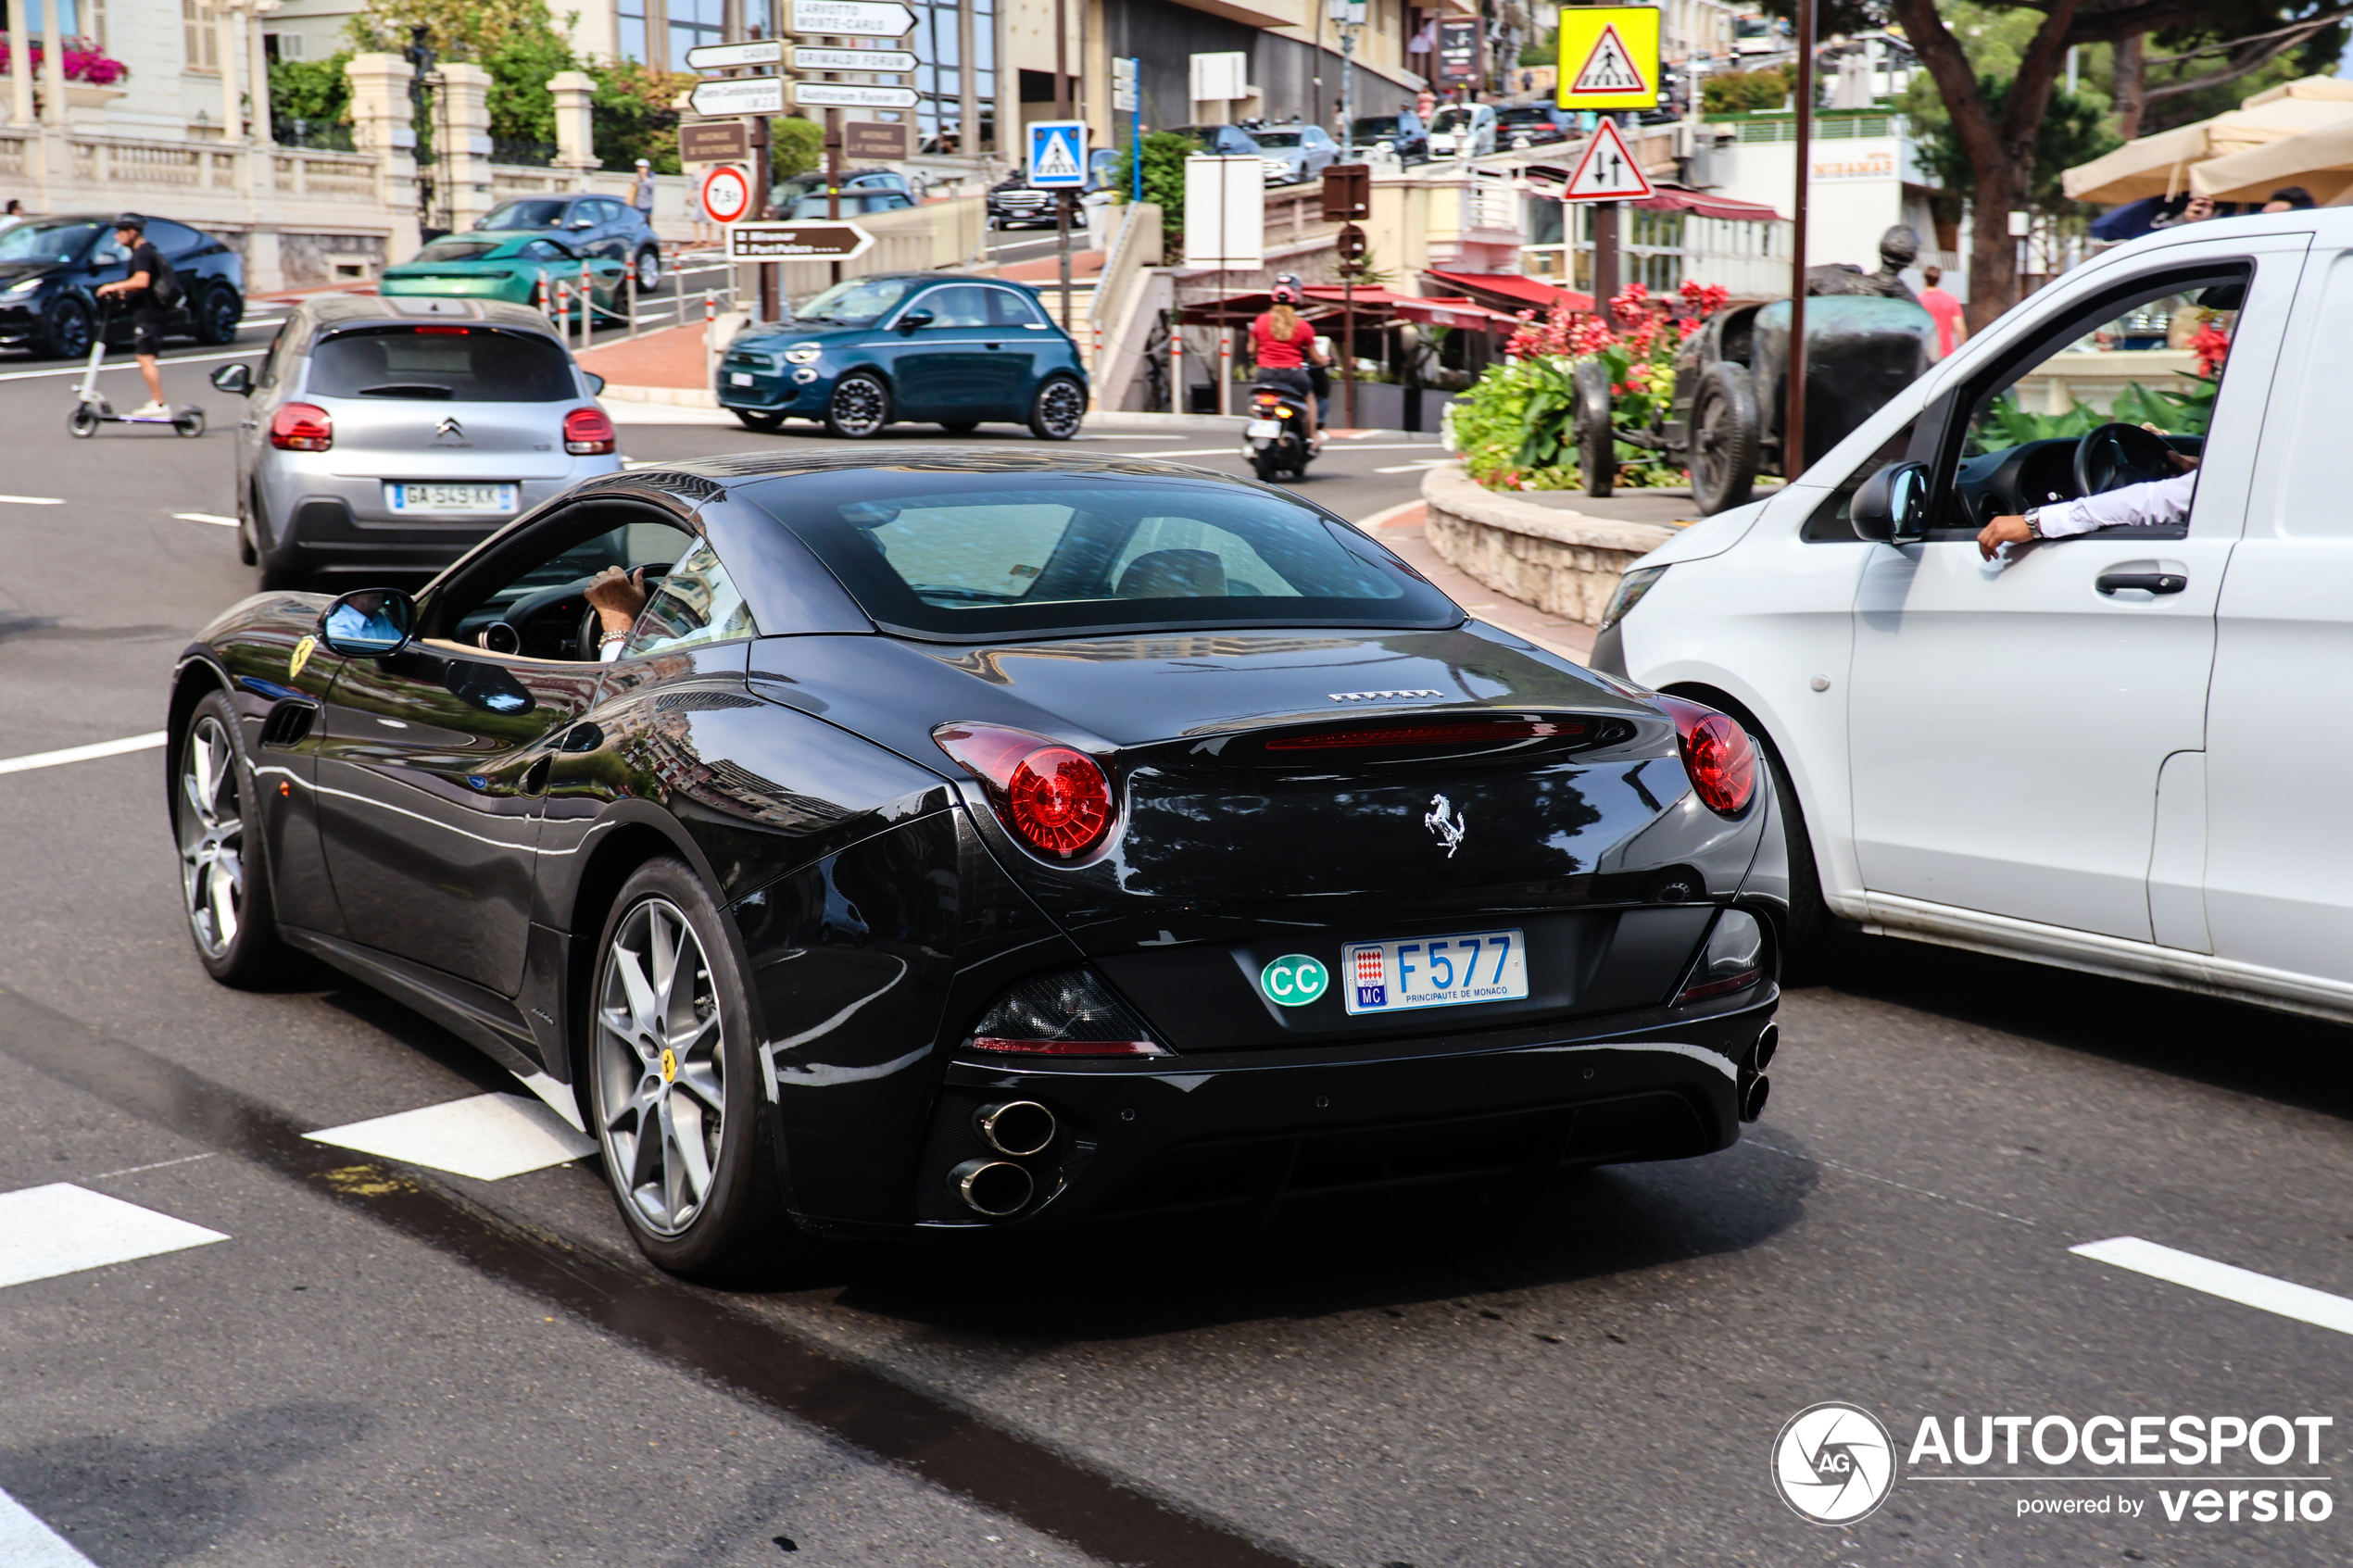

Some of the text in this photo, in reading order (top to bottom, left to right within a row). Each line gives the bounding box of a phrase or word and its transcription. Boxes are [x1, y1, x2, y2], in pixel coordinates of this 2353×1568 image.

[797, 4, 860, 16] LARVOTTO
[798, 18, 885, 31] MONTE-CARLO
[744, 46, 776, 59] CASINO
[799, 53, 906, 67] GRIMALDI FORUM
[801, 90, 855, 101] Auditorium
[860, 92, 896, 103] Rainier
[1813, 160, 1893, 176] MIRAMAR
[1398, 935, 1511, 993] F577
[1270, 965, 1319, 997] CC
[1362, 987, 1380, 1004] MC
[1406, 985, 1507, 1003] PRINCIPAUTE DE MONACO
